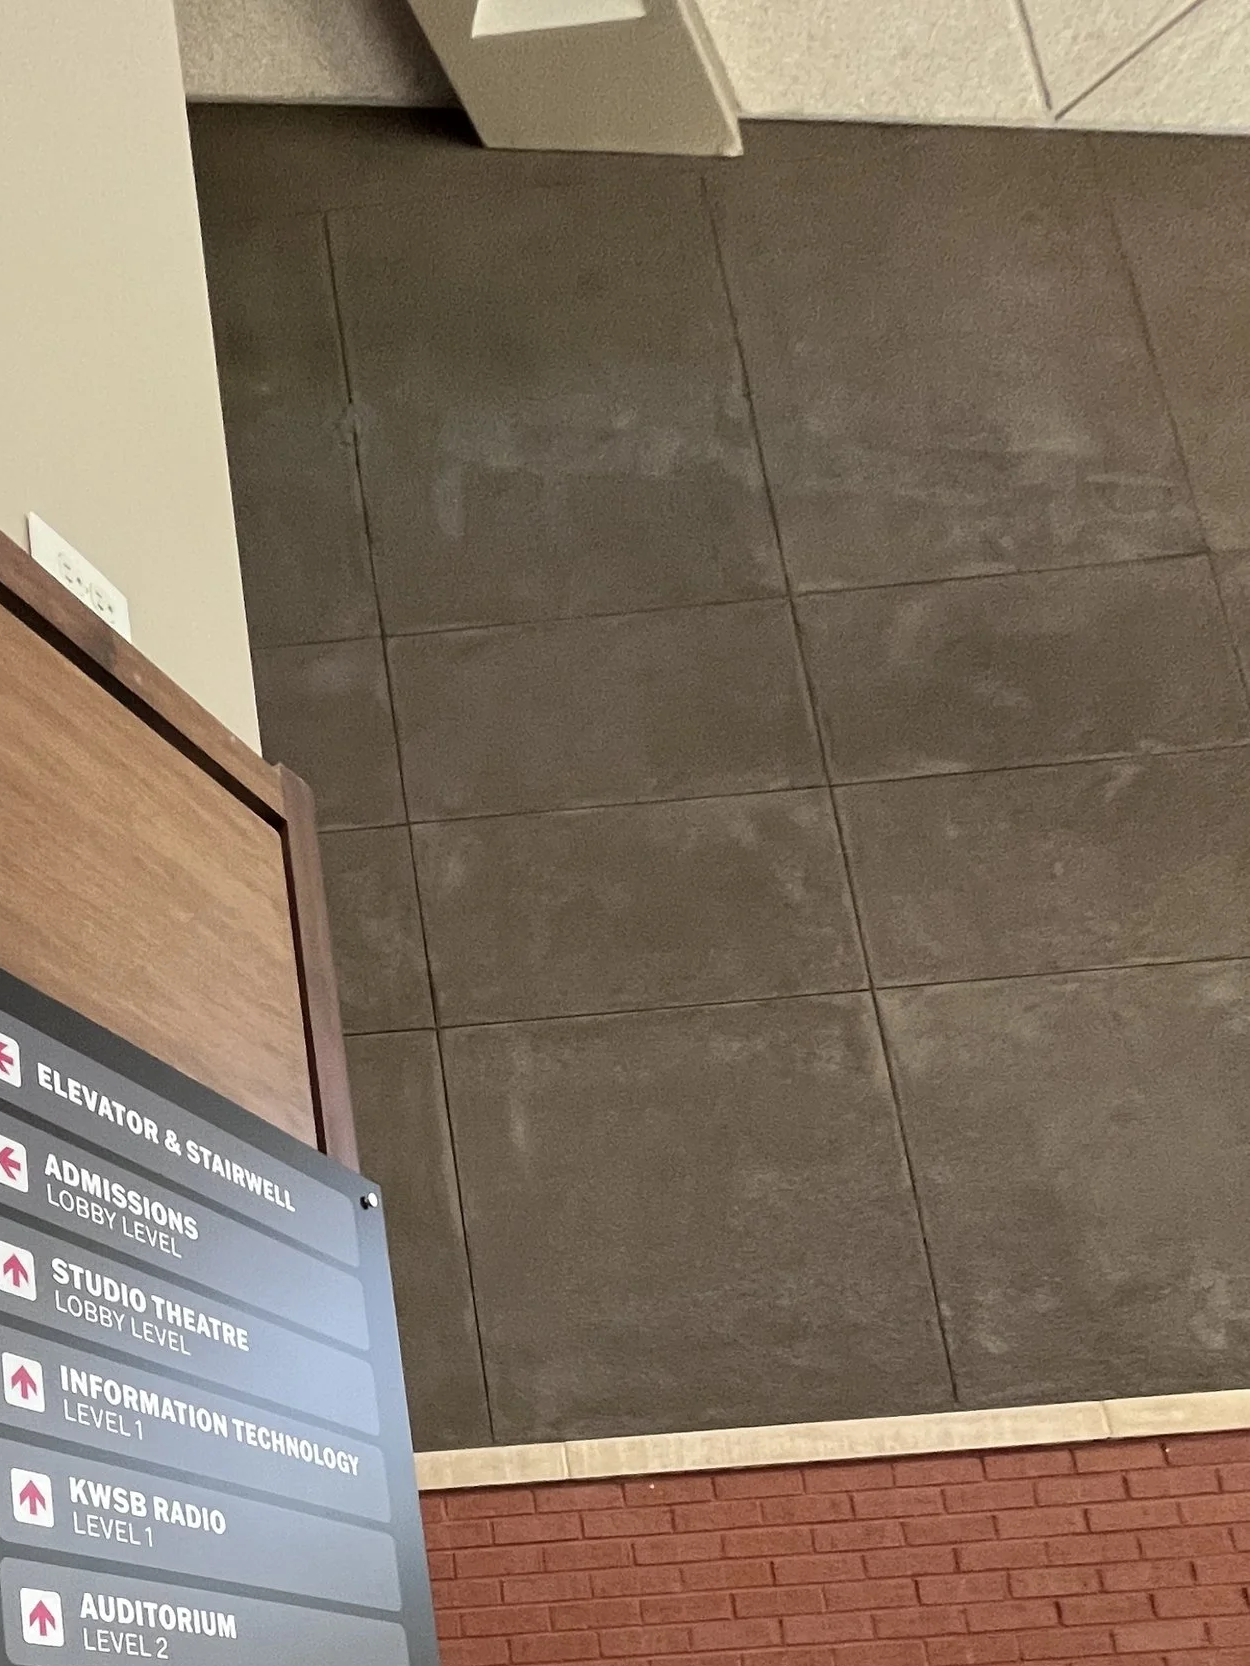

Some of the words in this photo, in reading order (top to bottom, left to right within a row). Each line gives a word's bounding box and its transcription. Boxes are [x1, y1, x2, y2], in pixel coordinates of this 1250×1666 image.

[37, 1062, 160, 1145] ELEVATOR
[164, 1129, 182, 1157] &
[185, 1139, 296, 1213] STAIRWELL
[44, 1153, 199, 1240] ADMISSIONS
[46, 1182, 117, 1231] LOBBY
[121, 1215, 182, 1259] LEVEL
[51, 1257, 147, 1313] STUDIO
[150, 1294, 250, 1352] THEATRE
[54, 1289, 125, 1332] LOBBY
[130, 1316, 191, 1356] LEVEL
[60, 1364, 228, 1438] INFORMATION
[231, 1418, 360, 1476] TECHNOLOGY
[63, 1398, 132, 1440] LEVEL
[134, 1418, 143, 1441] 1
[68, 1476, 148, 1518] KWSB
[152, 1495, 227, 1535] RADIO
[73, 1511, 142, 1546] LEVEL
[144, 1526, 153, 1548] 1
[79, 1592, 237, 1639] AUDITORIUM
[83, 1627, 153, 1658] LEVEL
[155, 1636, 169, 1660] 2
